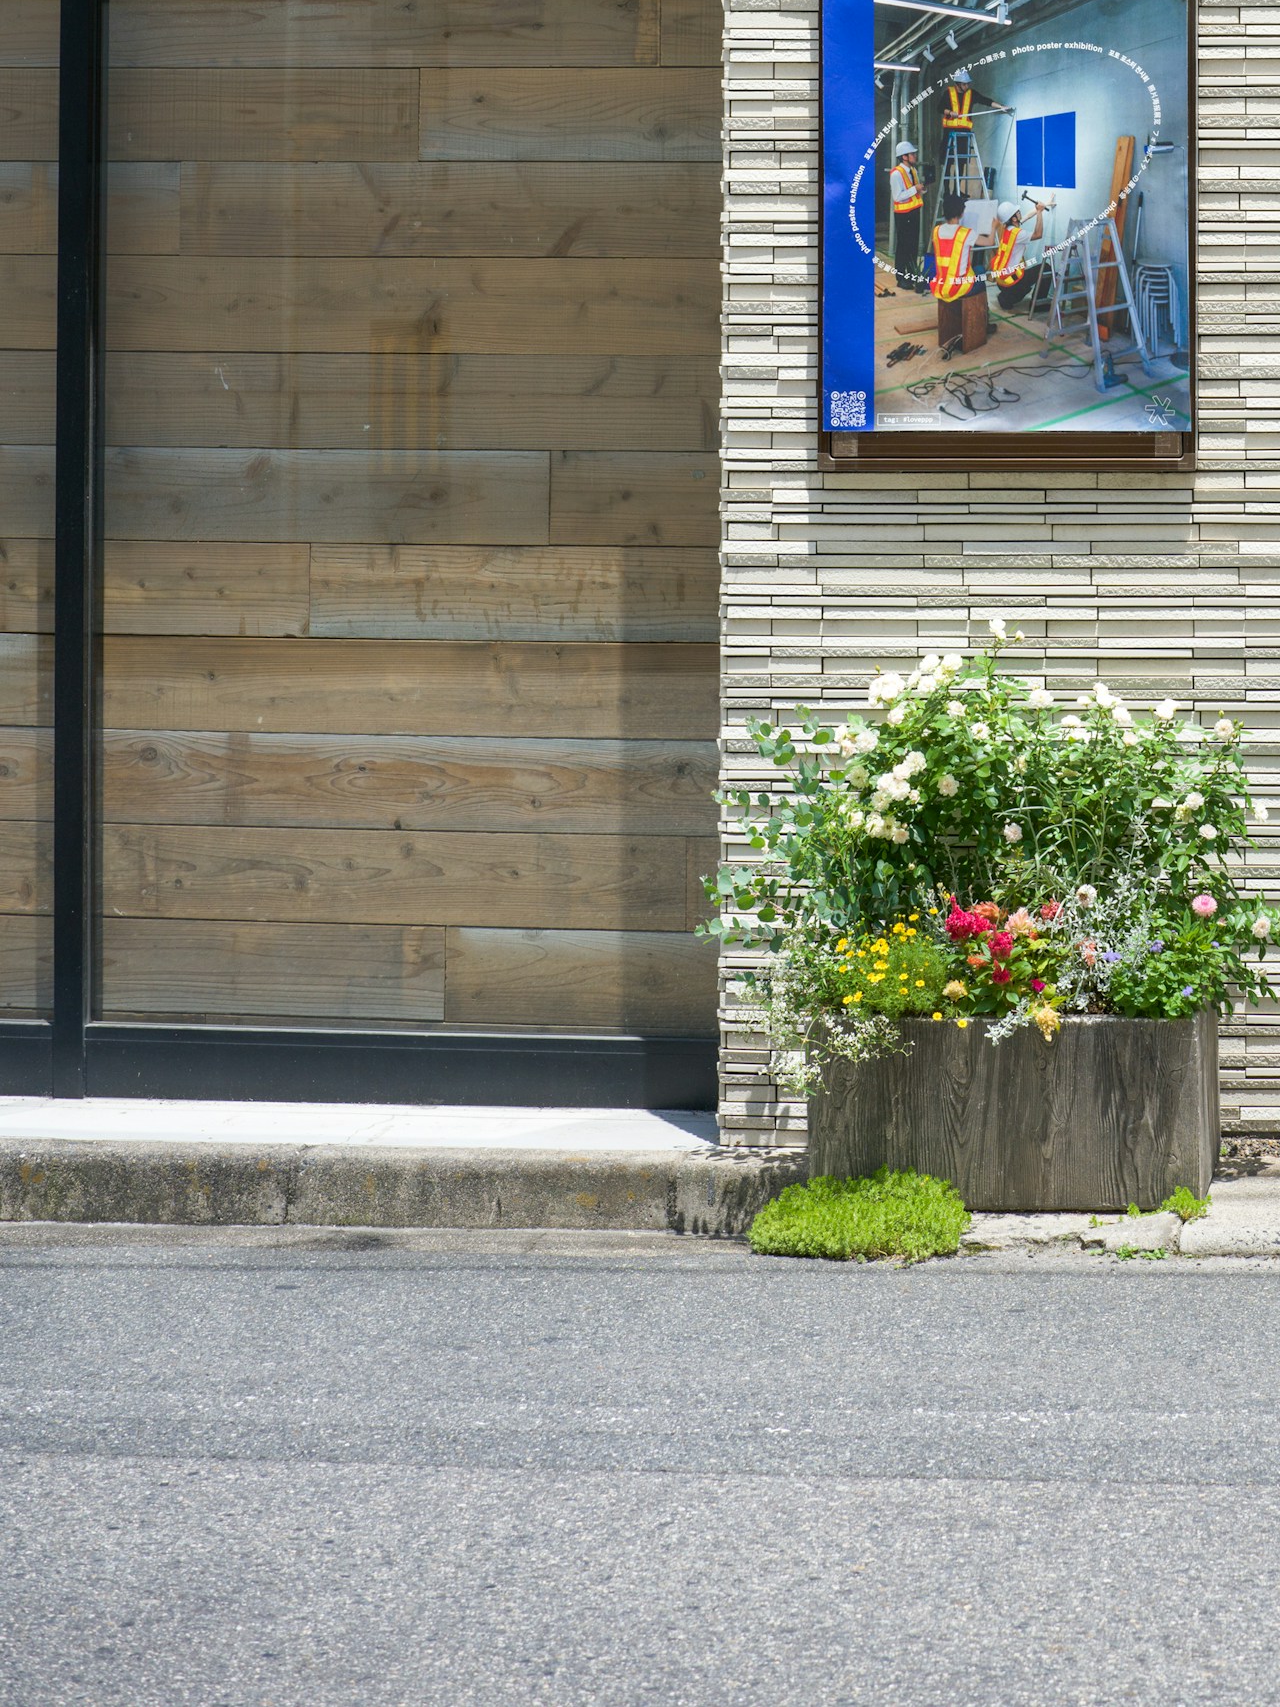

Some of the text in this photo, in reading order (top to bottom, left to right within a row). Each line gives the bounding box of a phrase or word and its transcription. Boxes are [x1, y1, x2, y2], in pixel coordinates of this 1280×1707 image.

[1012, 41, 1103, 56] photo poster exhibition
[848, 165, 871, 255] photo poster exhibition
[1041, 200, 1117, 258] photo poster exhibition
[883, 416, 899, 424] tag:
